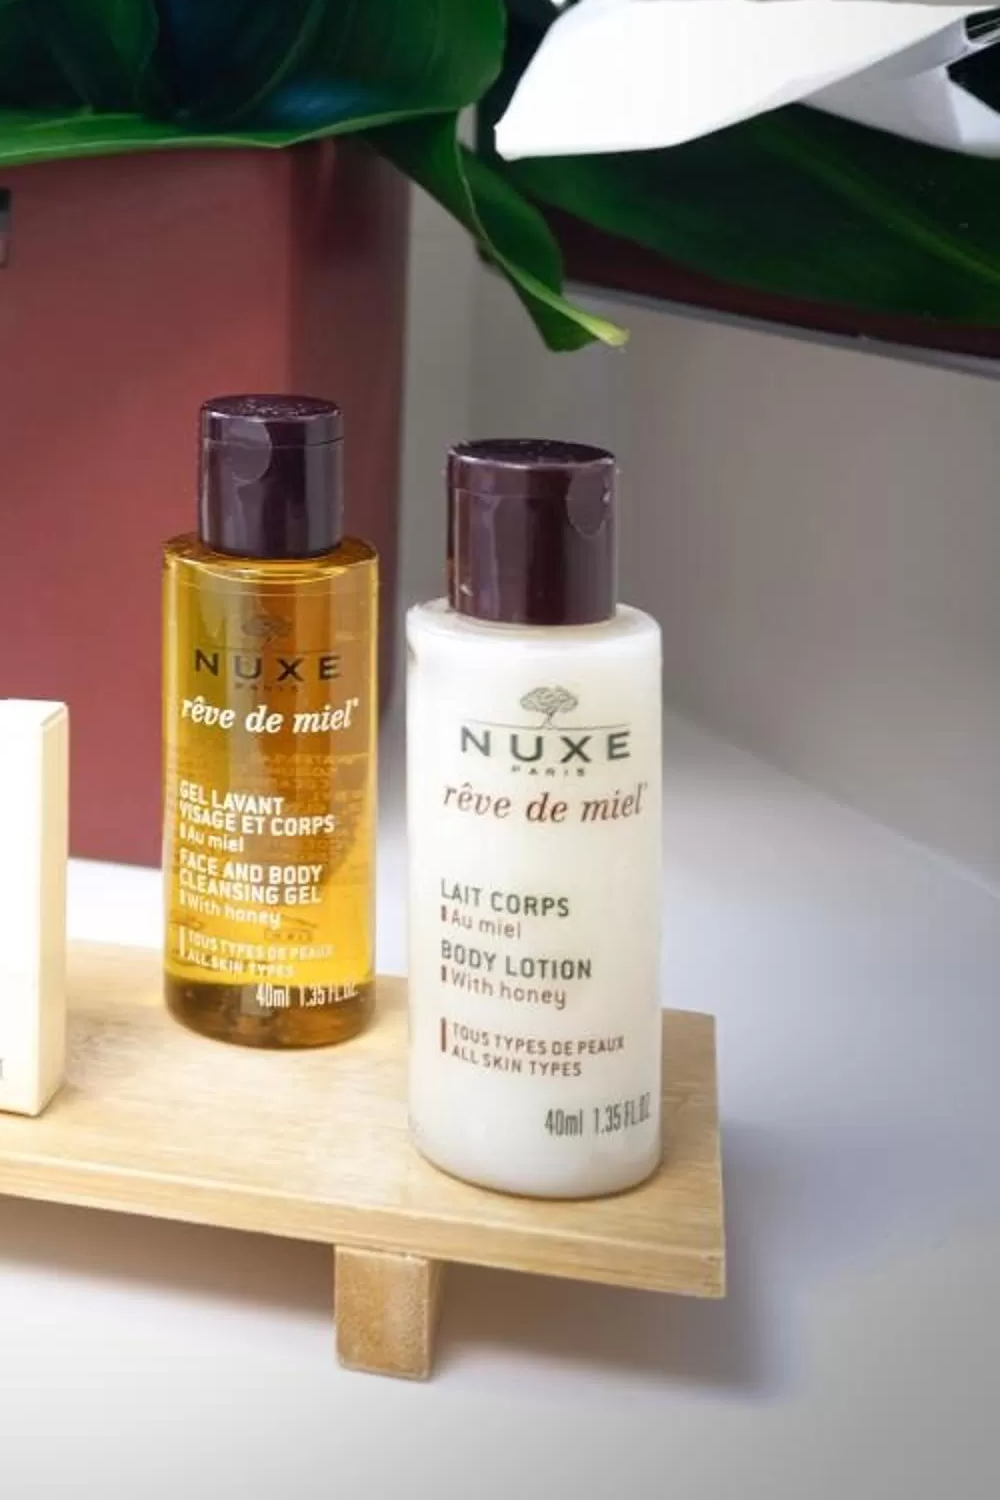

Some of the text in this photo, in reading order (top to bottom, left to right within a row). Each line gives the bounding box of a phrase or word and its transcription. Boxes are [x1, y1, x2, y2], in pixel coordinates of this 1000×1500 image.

[195, 649, 341, 682] NUXE
[182, 696, 352, 733] rêve de miel
[460, 725, 631, 763] NUXE
[511, 765, 586, 776] PARIS
[180, 780, 284, 816] GEL LAVANT
[444, 782, 643, 823] rêve de miel
[179, 800, 335, 836] VISAGE ET CORPS
[187, 826, 244, 852] Au miel
[180, 848, 322, 884] FACE AND BODY
[179, 868, 322, 904] CLEANSING GEL
[441, 878, 570, 917] LAIT CORPS
[187, 893, 281, 930] With honey
[451, 908, 522, 939] Au miel
[188, 929, 217, 950] TOUS
[220, 938, 264, 959] TYPES
[441, 939, 592, 980] BODY LOTION
[212, 956, 243, 974] SKIN
[256, 981, 290, 1008] 40ml
[300, 984, 325, 1007] 1.35
[451, 968, 566, 1010] With honey
[453, 1022, 625, 1056] TOUS TYPES DE PEAUX
[452, 1044, 582, 1076] ALL SKIN TYPES
[544, 1108, 583, 1136] 40ml
[594, 1102, 621, 1136] 1.35
